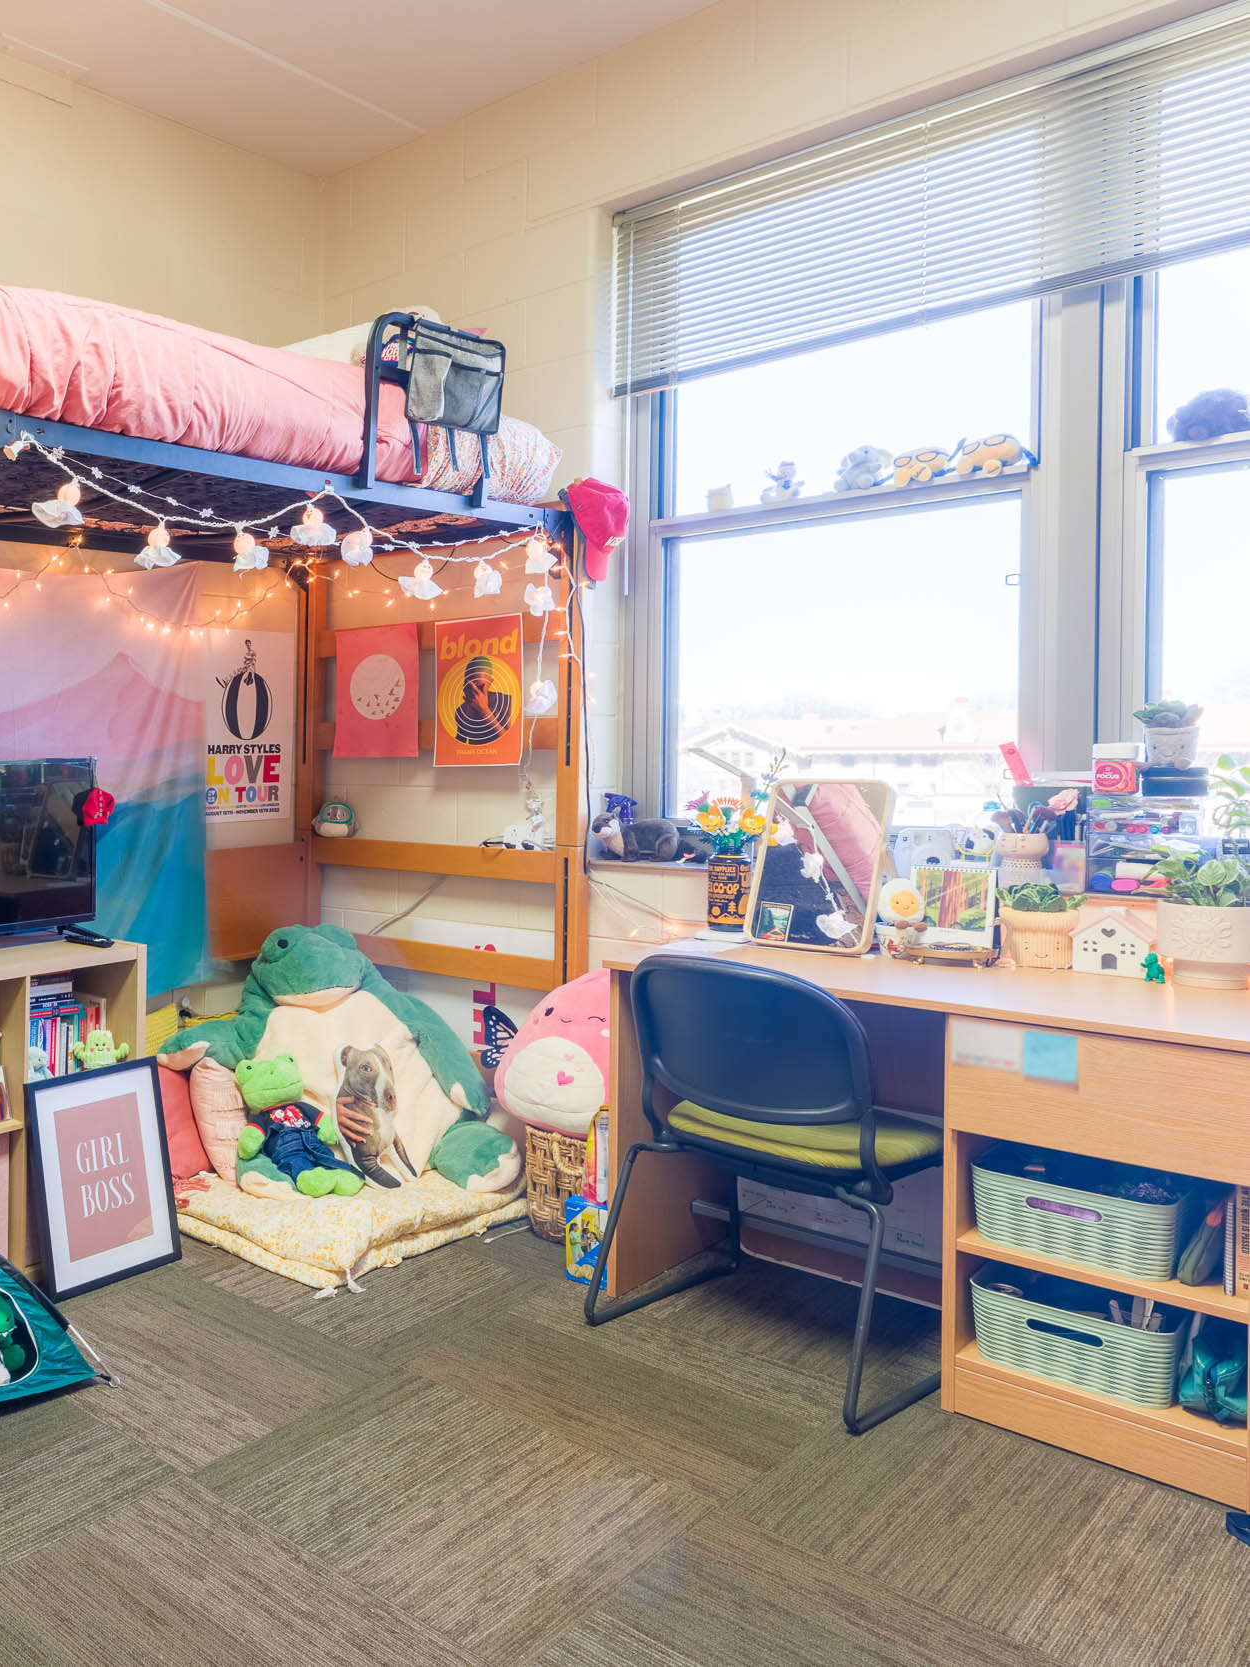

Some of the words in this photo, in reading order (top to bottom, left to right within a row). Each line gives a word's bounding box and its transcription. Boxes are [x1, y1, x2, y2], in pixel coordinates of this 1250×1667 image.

[439, 627, 519, 660] blond
[207, 744, 242, 755] HARRY
[243, 743, 281, 754] STYLES
[206, 754, 281, 786] LOVE
[205, 787, 230, 805] ON
[235, 785, 279, 803] TOUR
[76, 1132, 130, 1175] GIRL
[80, 1171, 135, 1218] BOSS
